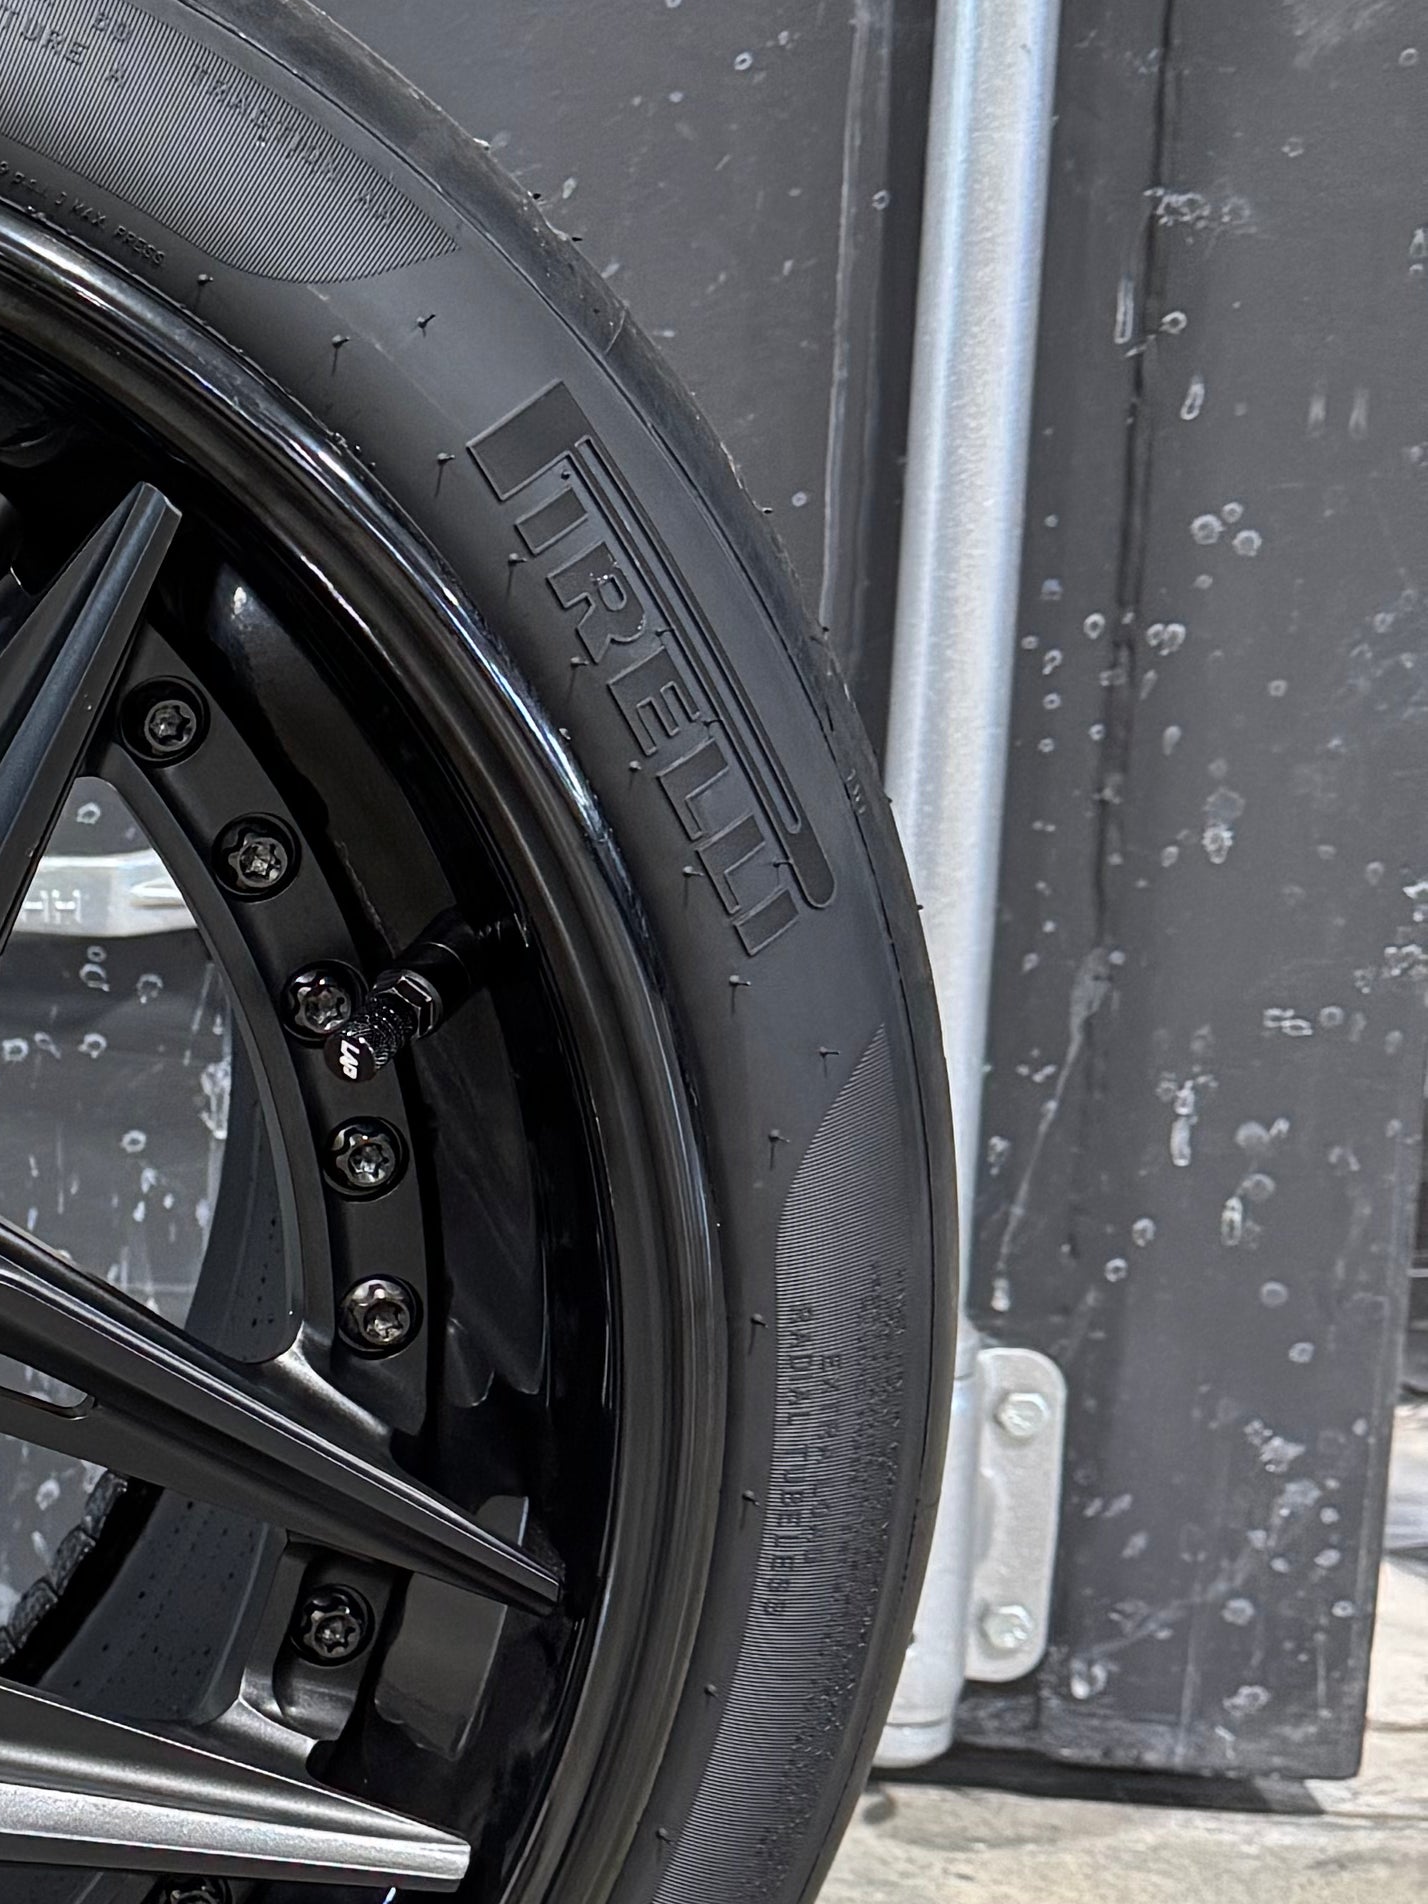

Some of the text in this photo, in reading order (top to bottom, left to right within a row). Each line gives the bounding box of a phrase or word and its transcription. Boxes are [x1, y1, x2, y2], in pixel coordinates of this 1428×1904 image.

[465, 378, 836, 957] PIRELLI
[759, 1297, 814, 1620] RADIAL TUBELESS
